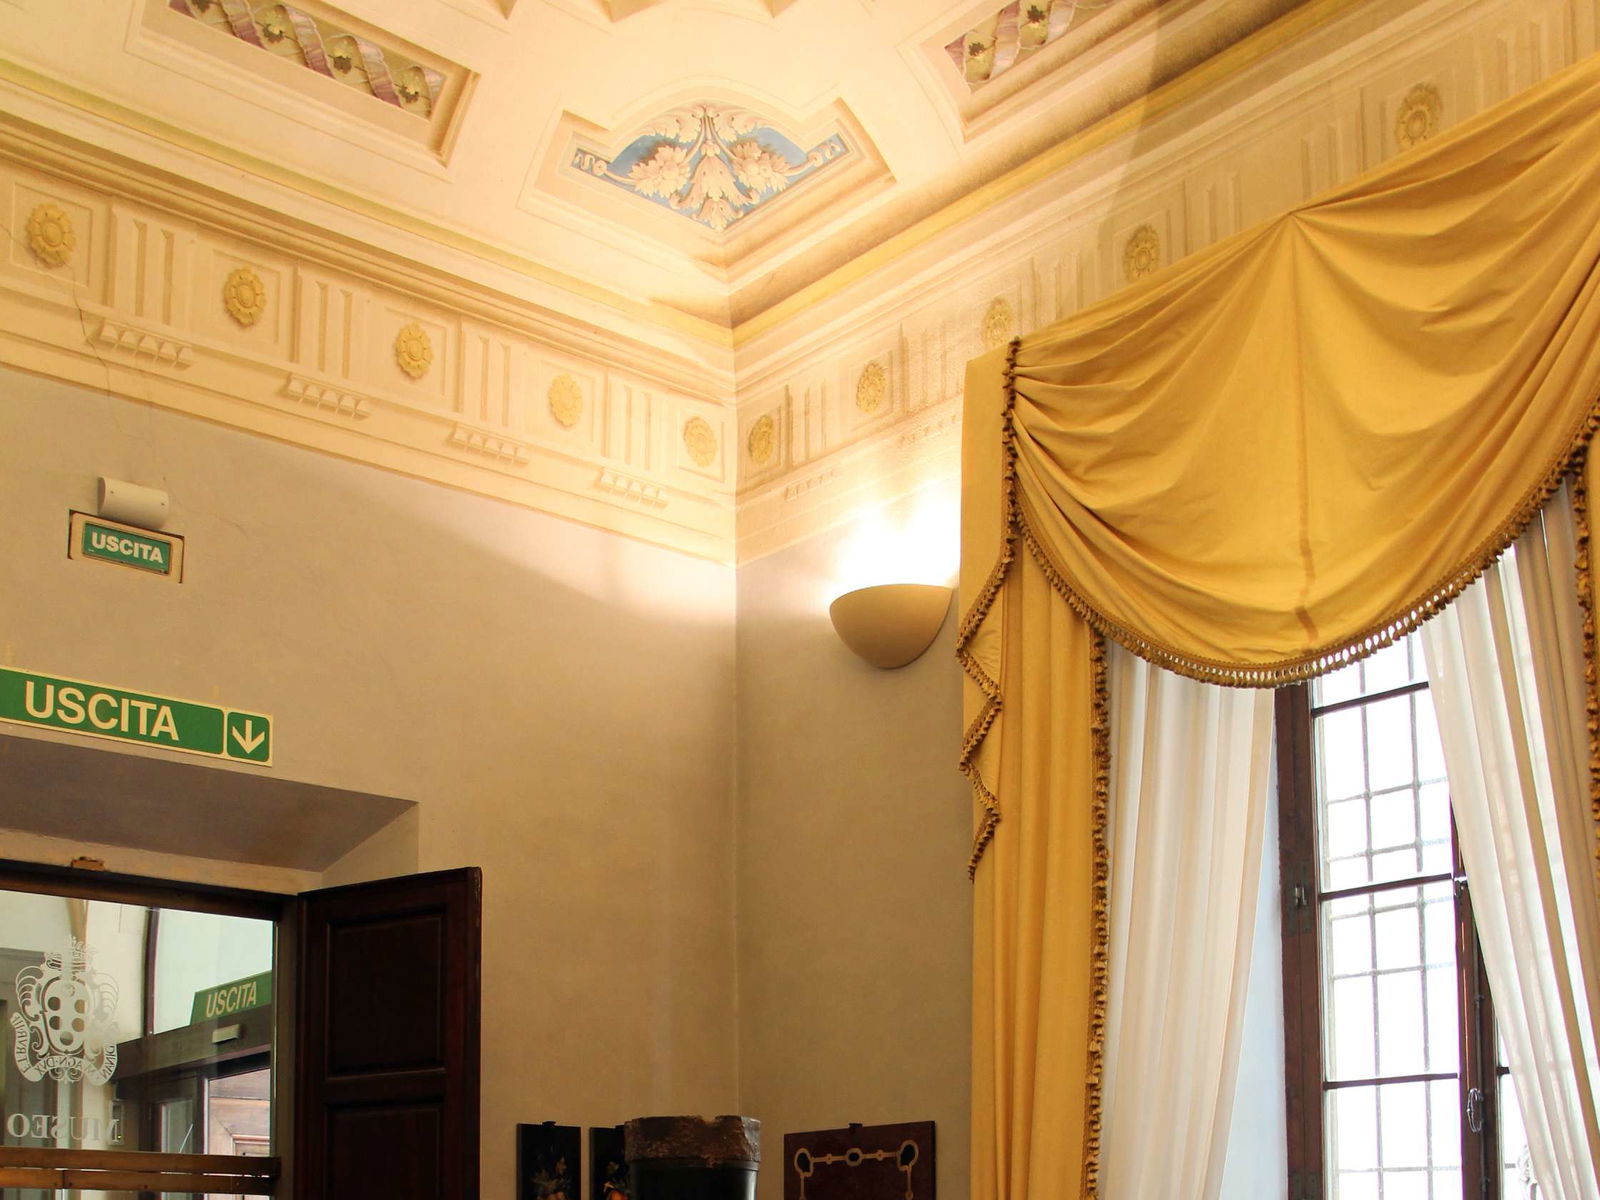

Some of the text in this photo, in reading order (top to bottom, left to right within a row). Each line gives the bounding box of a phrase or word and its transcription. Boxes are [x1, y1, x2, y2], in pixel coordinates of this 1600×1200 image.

[91, 532, 164, 564] USCITA
[25, 680, 179, 741] USCITA
[206, 981, 257, 1018] USCITA
